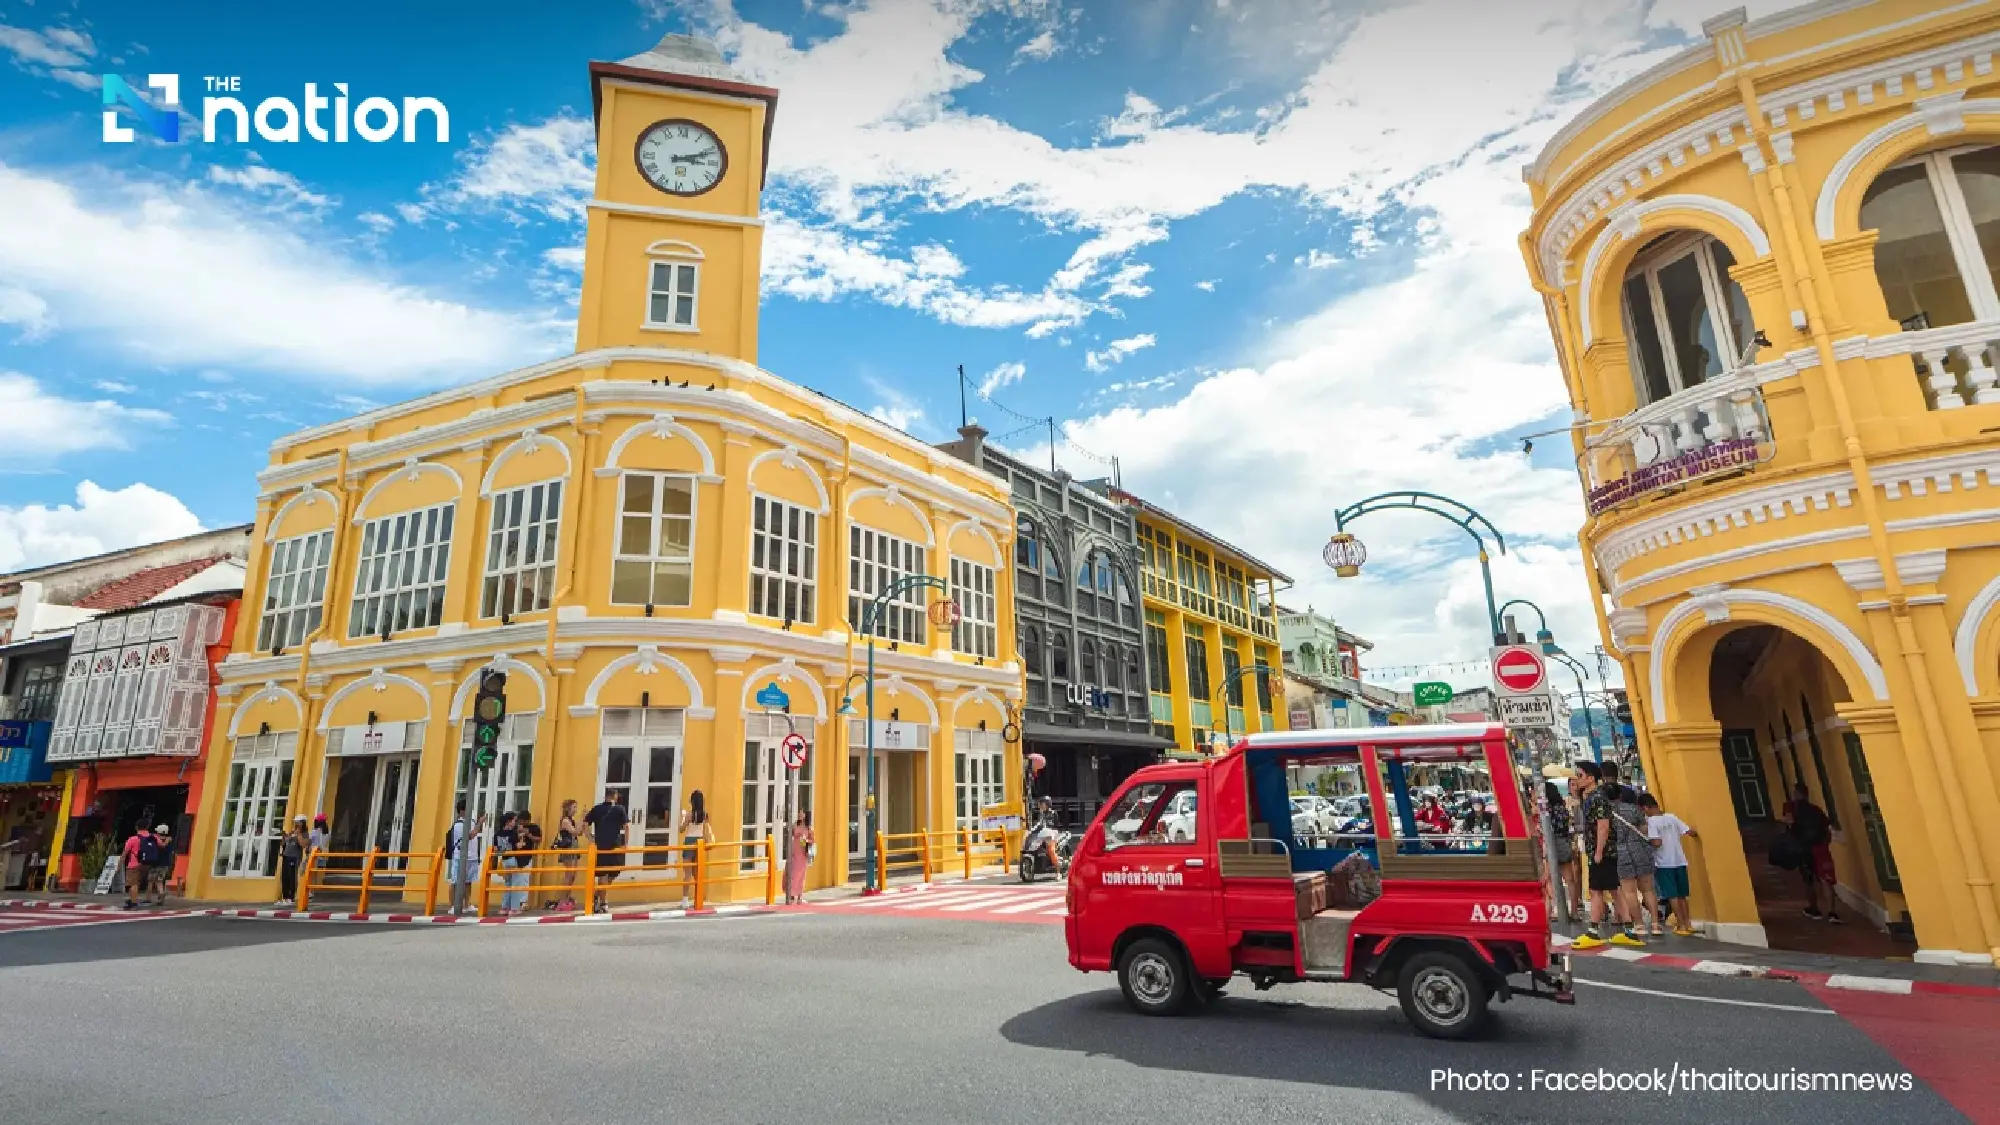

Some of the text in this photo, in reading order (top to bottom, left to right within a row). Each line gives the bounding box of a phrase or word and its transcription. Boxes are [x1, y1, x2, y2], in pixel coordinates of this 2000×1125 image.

[1686, 448, 1758, 476] MUSEUM
[1502, 696, 1549, 714] ห้ามเข้า
[1102, 864, 1183, 891] เขตจังหวัดภูเก็ต
